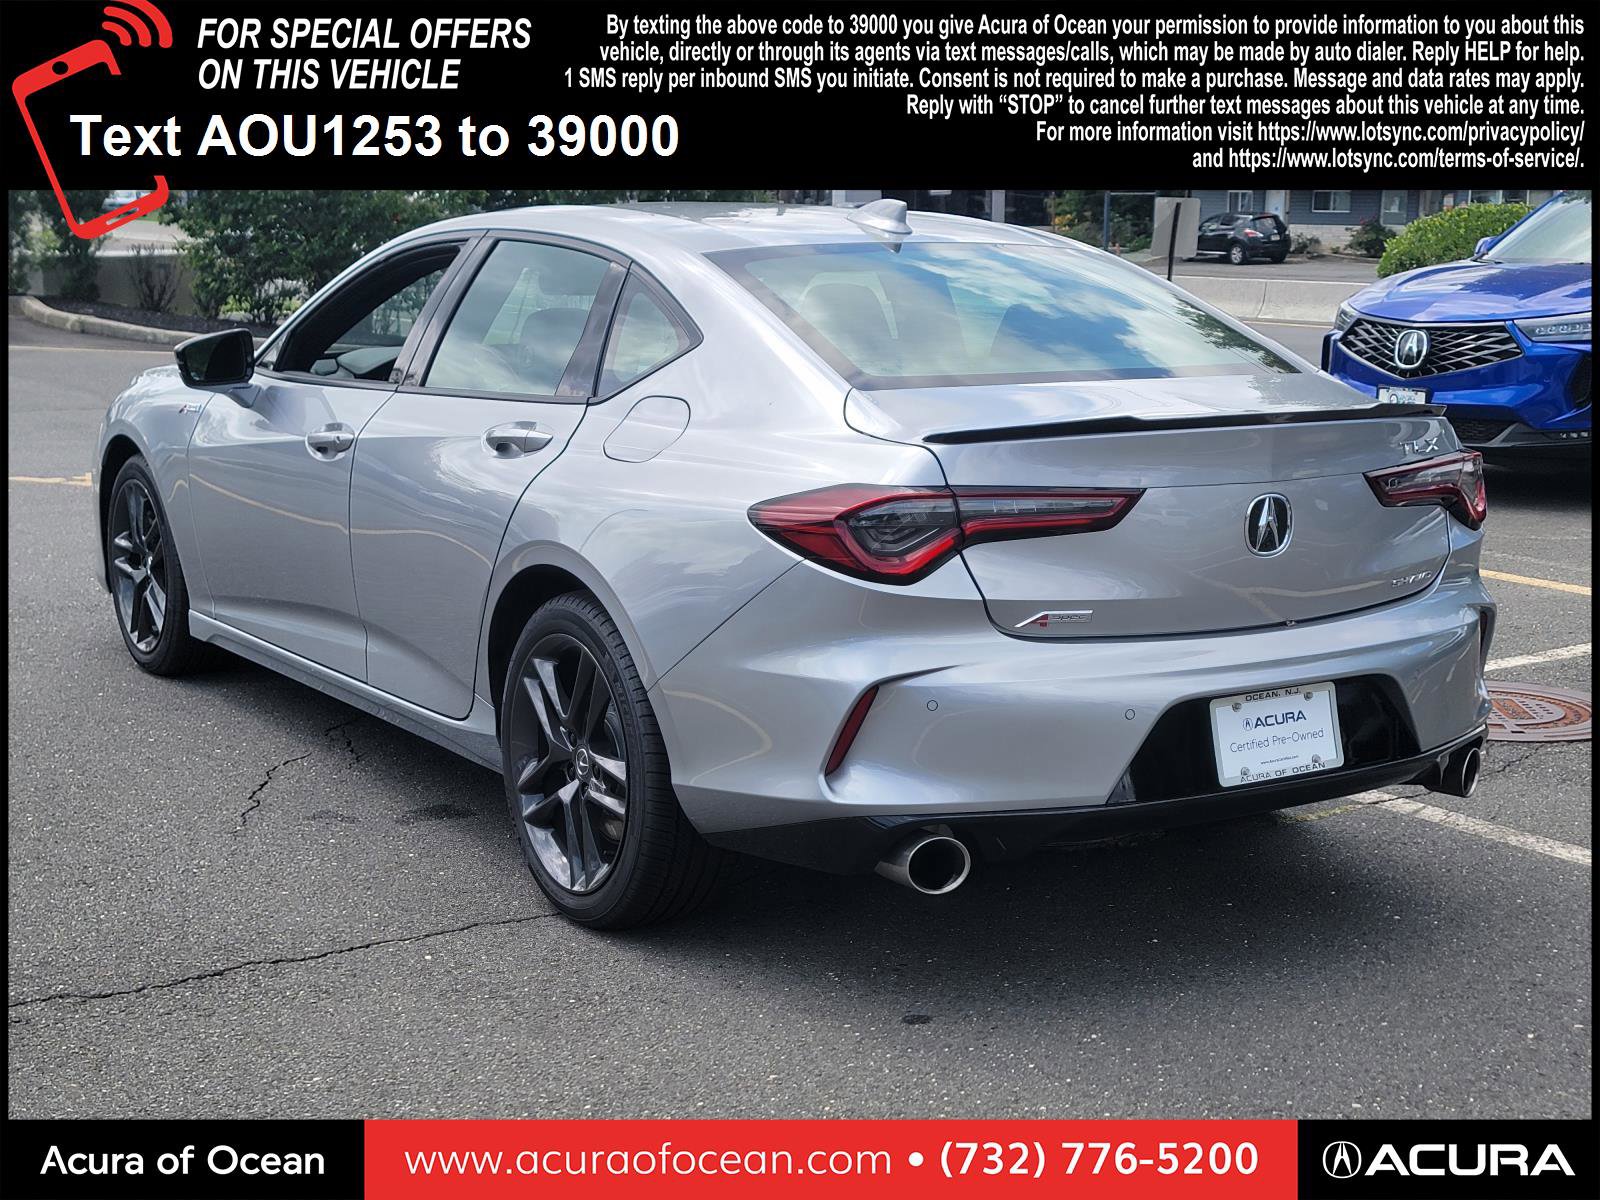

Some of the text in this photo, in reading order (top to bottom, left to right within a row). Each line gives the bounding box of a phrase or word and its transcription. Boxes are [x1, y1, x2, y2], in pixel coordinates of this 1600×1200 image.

[1254, 709, 1307, 729] ACURA
[1230, 727, 1324, 753] Certified Pre-Owned
[1240, 761, 1326, 783] ACURA OF OCEAN
